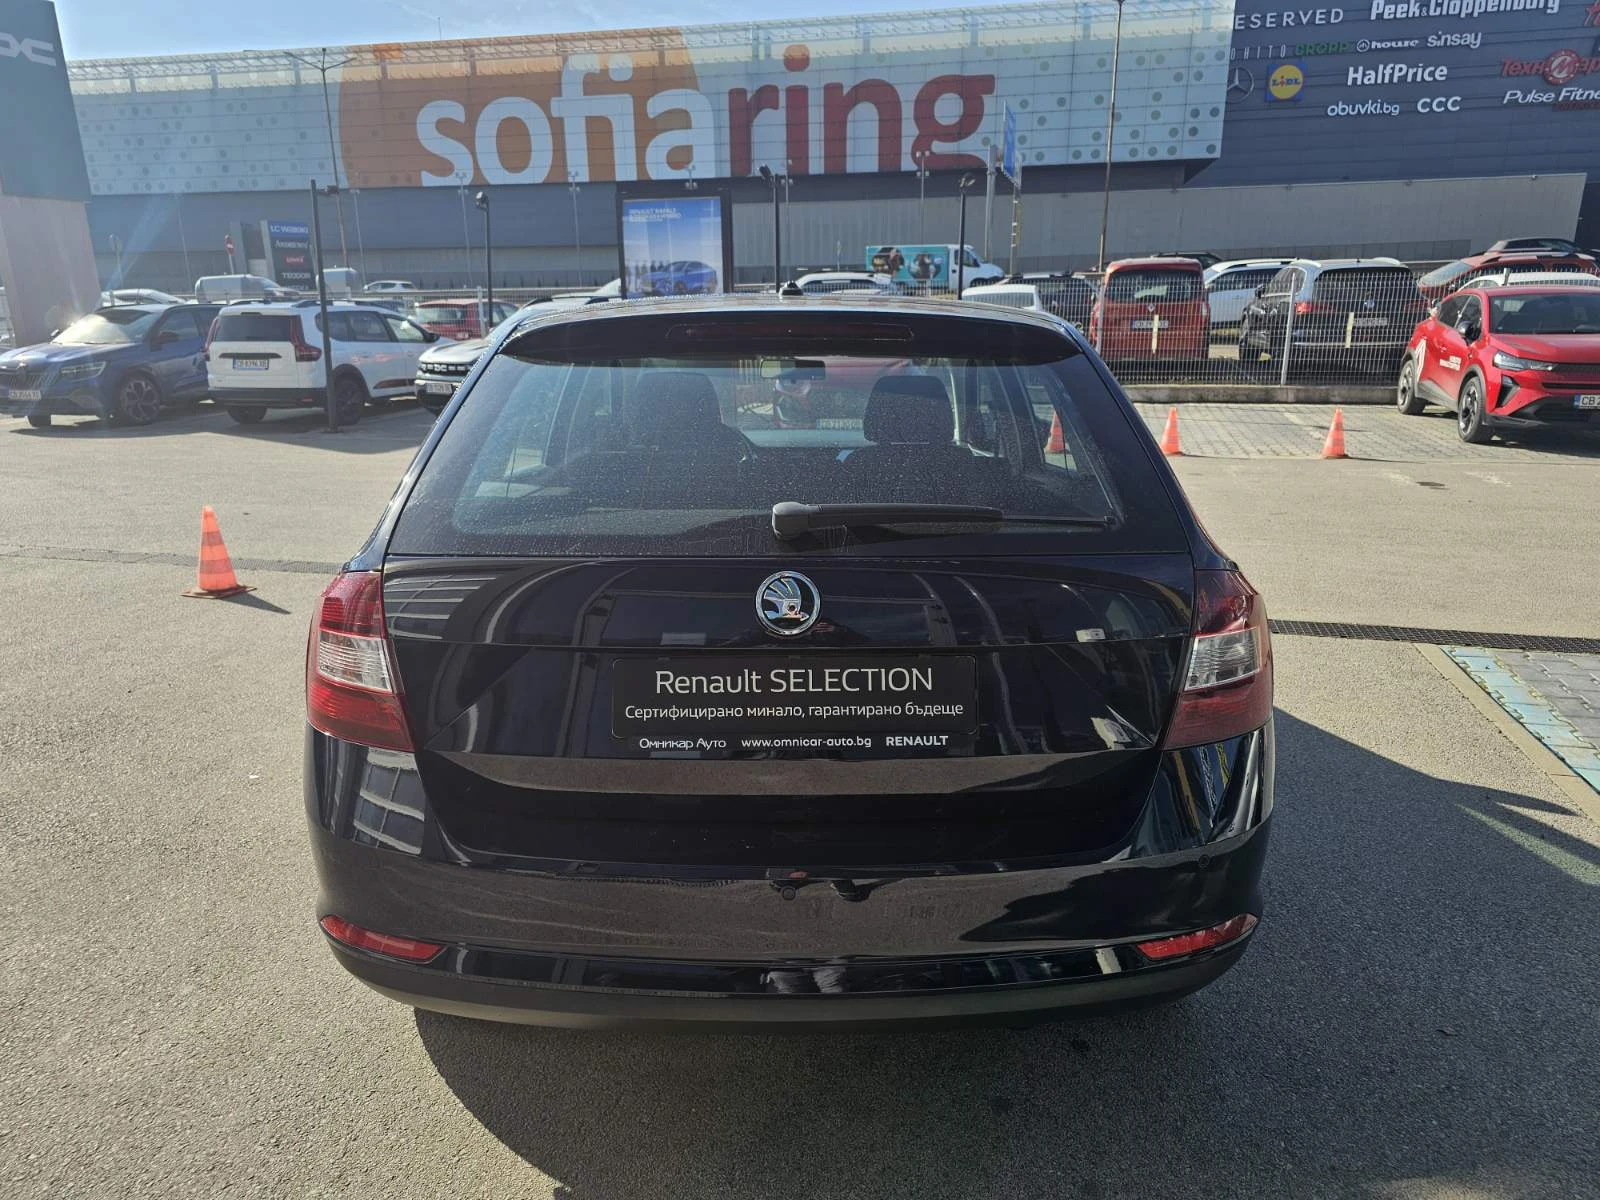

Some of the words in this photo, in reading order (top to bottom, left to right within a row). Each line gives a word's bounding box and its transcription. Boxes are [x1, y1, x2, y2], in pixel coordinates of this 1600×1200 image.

[1426, 30, 1482, 49] sinsay
[1347, 63, 1448, 86] HalfPrice
[1416, 95, 1462, 113] CCC
[1503, 89, 1556, 104] Pulse
[1327, 99, 1400, 117] obuvki.bg
[655, 669, 762, 694] Renault
[770, 667, 933, 693] SELECTION
[624, 704, 744, 722] Сертифицирано
[746, 706, 807, 720] минало,
[808, 705, 902, 719] гарантирано
[905, 701, 964, 717] бъдеще
[639, 737, 694, 751] Омникар
[696, 737, 727, 751] Ауто
[741, 735, 872, 749] www.omnicar-auto.bg
[885, 735, 949, 747] RENAULT
